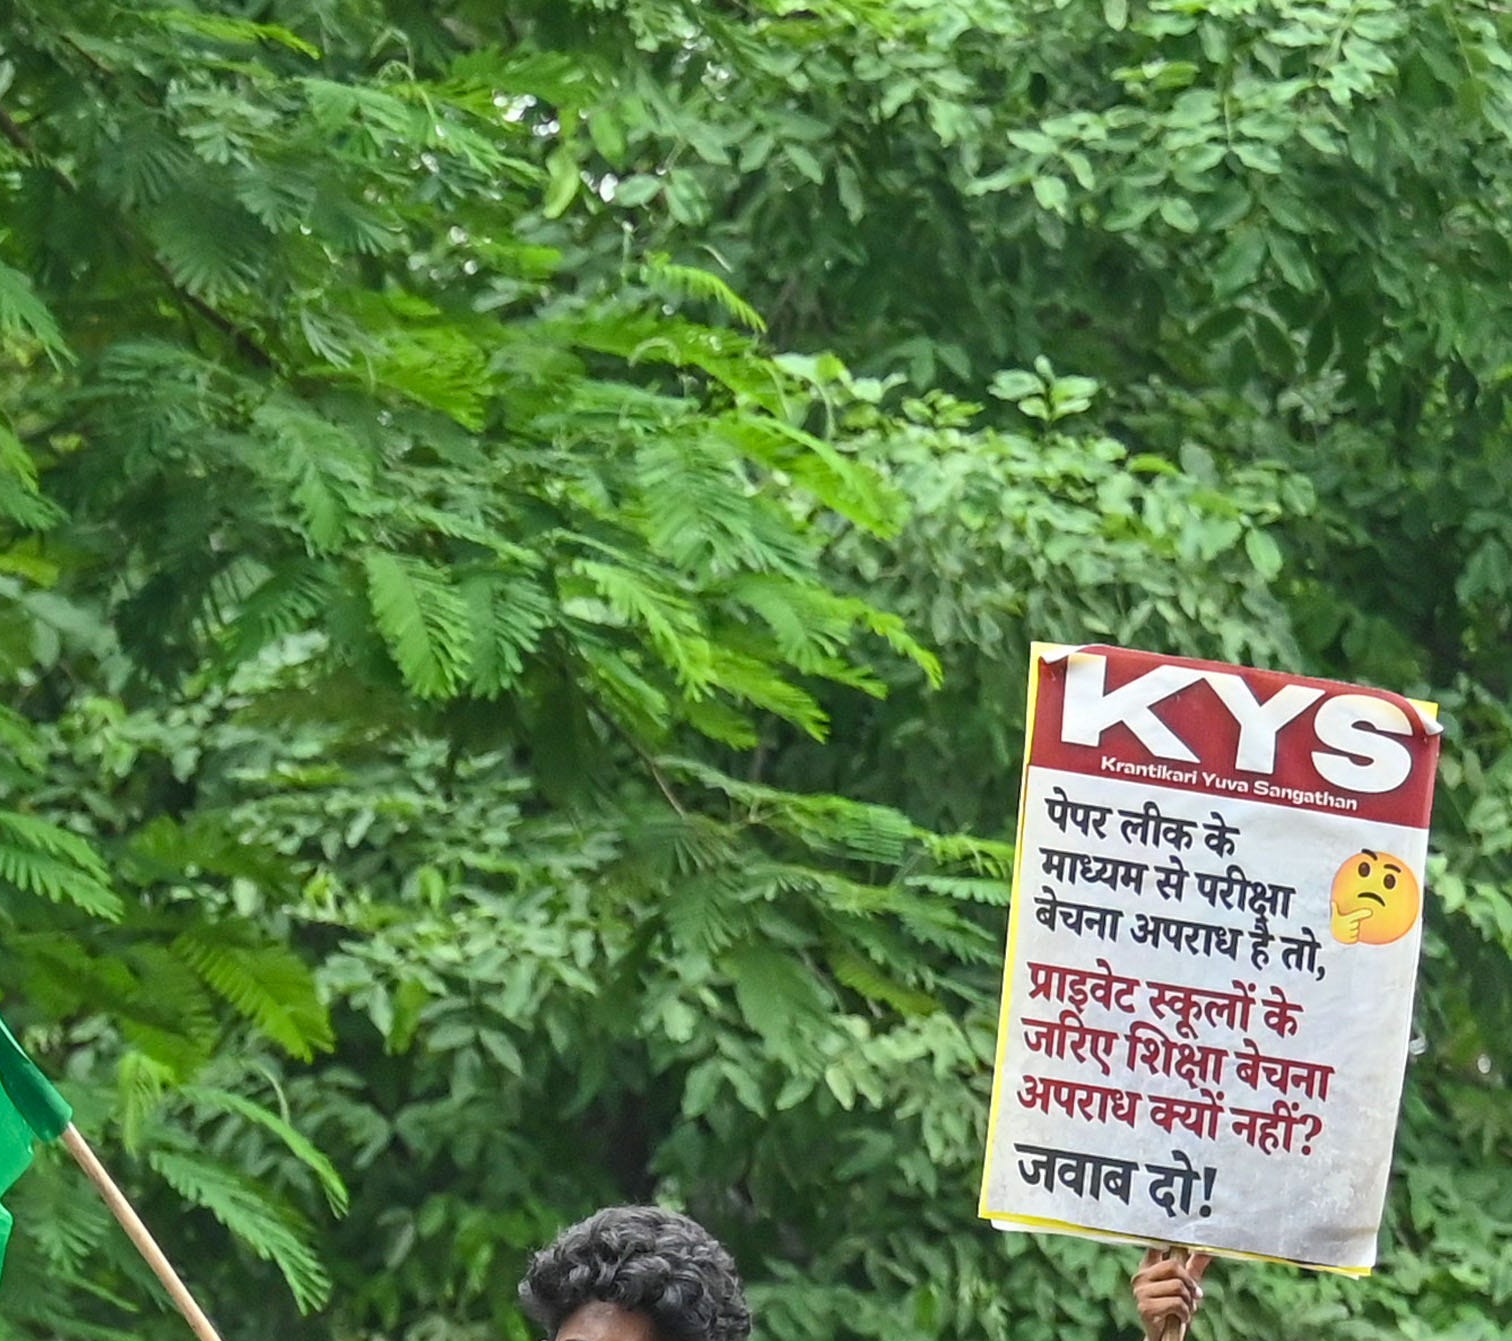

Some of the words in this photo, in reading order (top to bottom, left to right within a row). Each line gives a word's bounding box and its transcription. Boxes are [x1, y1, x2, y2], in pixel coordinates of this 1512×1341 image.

[1061, 653, 1413, 793] KYS
[1045, 787, 1112, 838] पेपर
[1118, 802, 1197, 850] लीक
[1203, 812, 1240, 857] के
[1101, 756, 1197, 785] Krantikari
[1203, 772, 1248, 793] Yuva
[1254, 780, 1357, 812] Sangathan
[1040, 848, 1149, 894] माध्यम
[1154, 856, 1189, 900] से
[1195, 864, 1295, 919] परीक्षा
[1035, 886, 1123, 941] बेचना
[1131, 914, 1243, 960] अपराध
[1249, 916, 1275, 967] है
[1280, 927, 1324, 980] तो,
[1028, 959, 1140, 1013] प्राइवेट
[1147, 981, 1256, 1039] स्कूलों
[1262, 986, 1303, 1037] के
[1022, 1010, 1118, 1075] जरिए
[1125, 1021, 1228, 1088] शिक्षा
[1235, 1039, 1334, 1101] बेचना
[1018, 1076, 1142, 1127] अपराध
[1148, 1089, 1224, 1140] क्यों
[1230, 1100, 1322, 1155] नहीं?
[1015, 1144, 1139, 1205] जवाब
[1145, 1150, 1216, 1217] दो!
